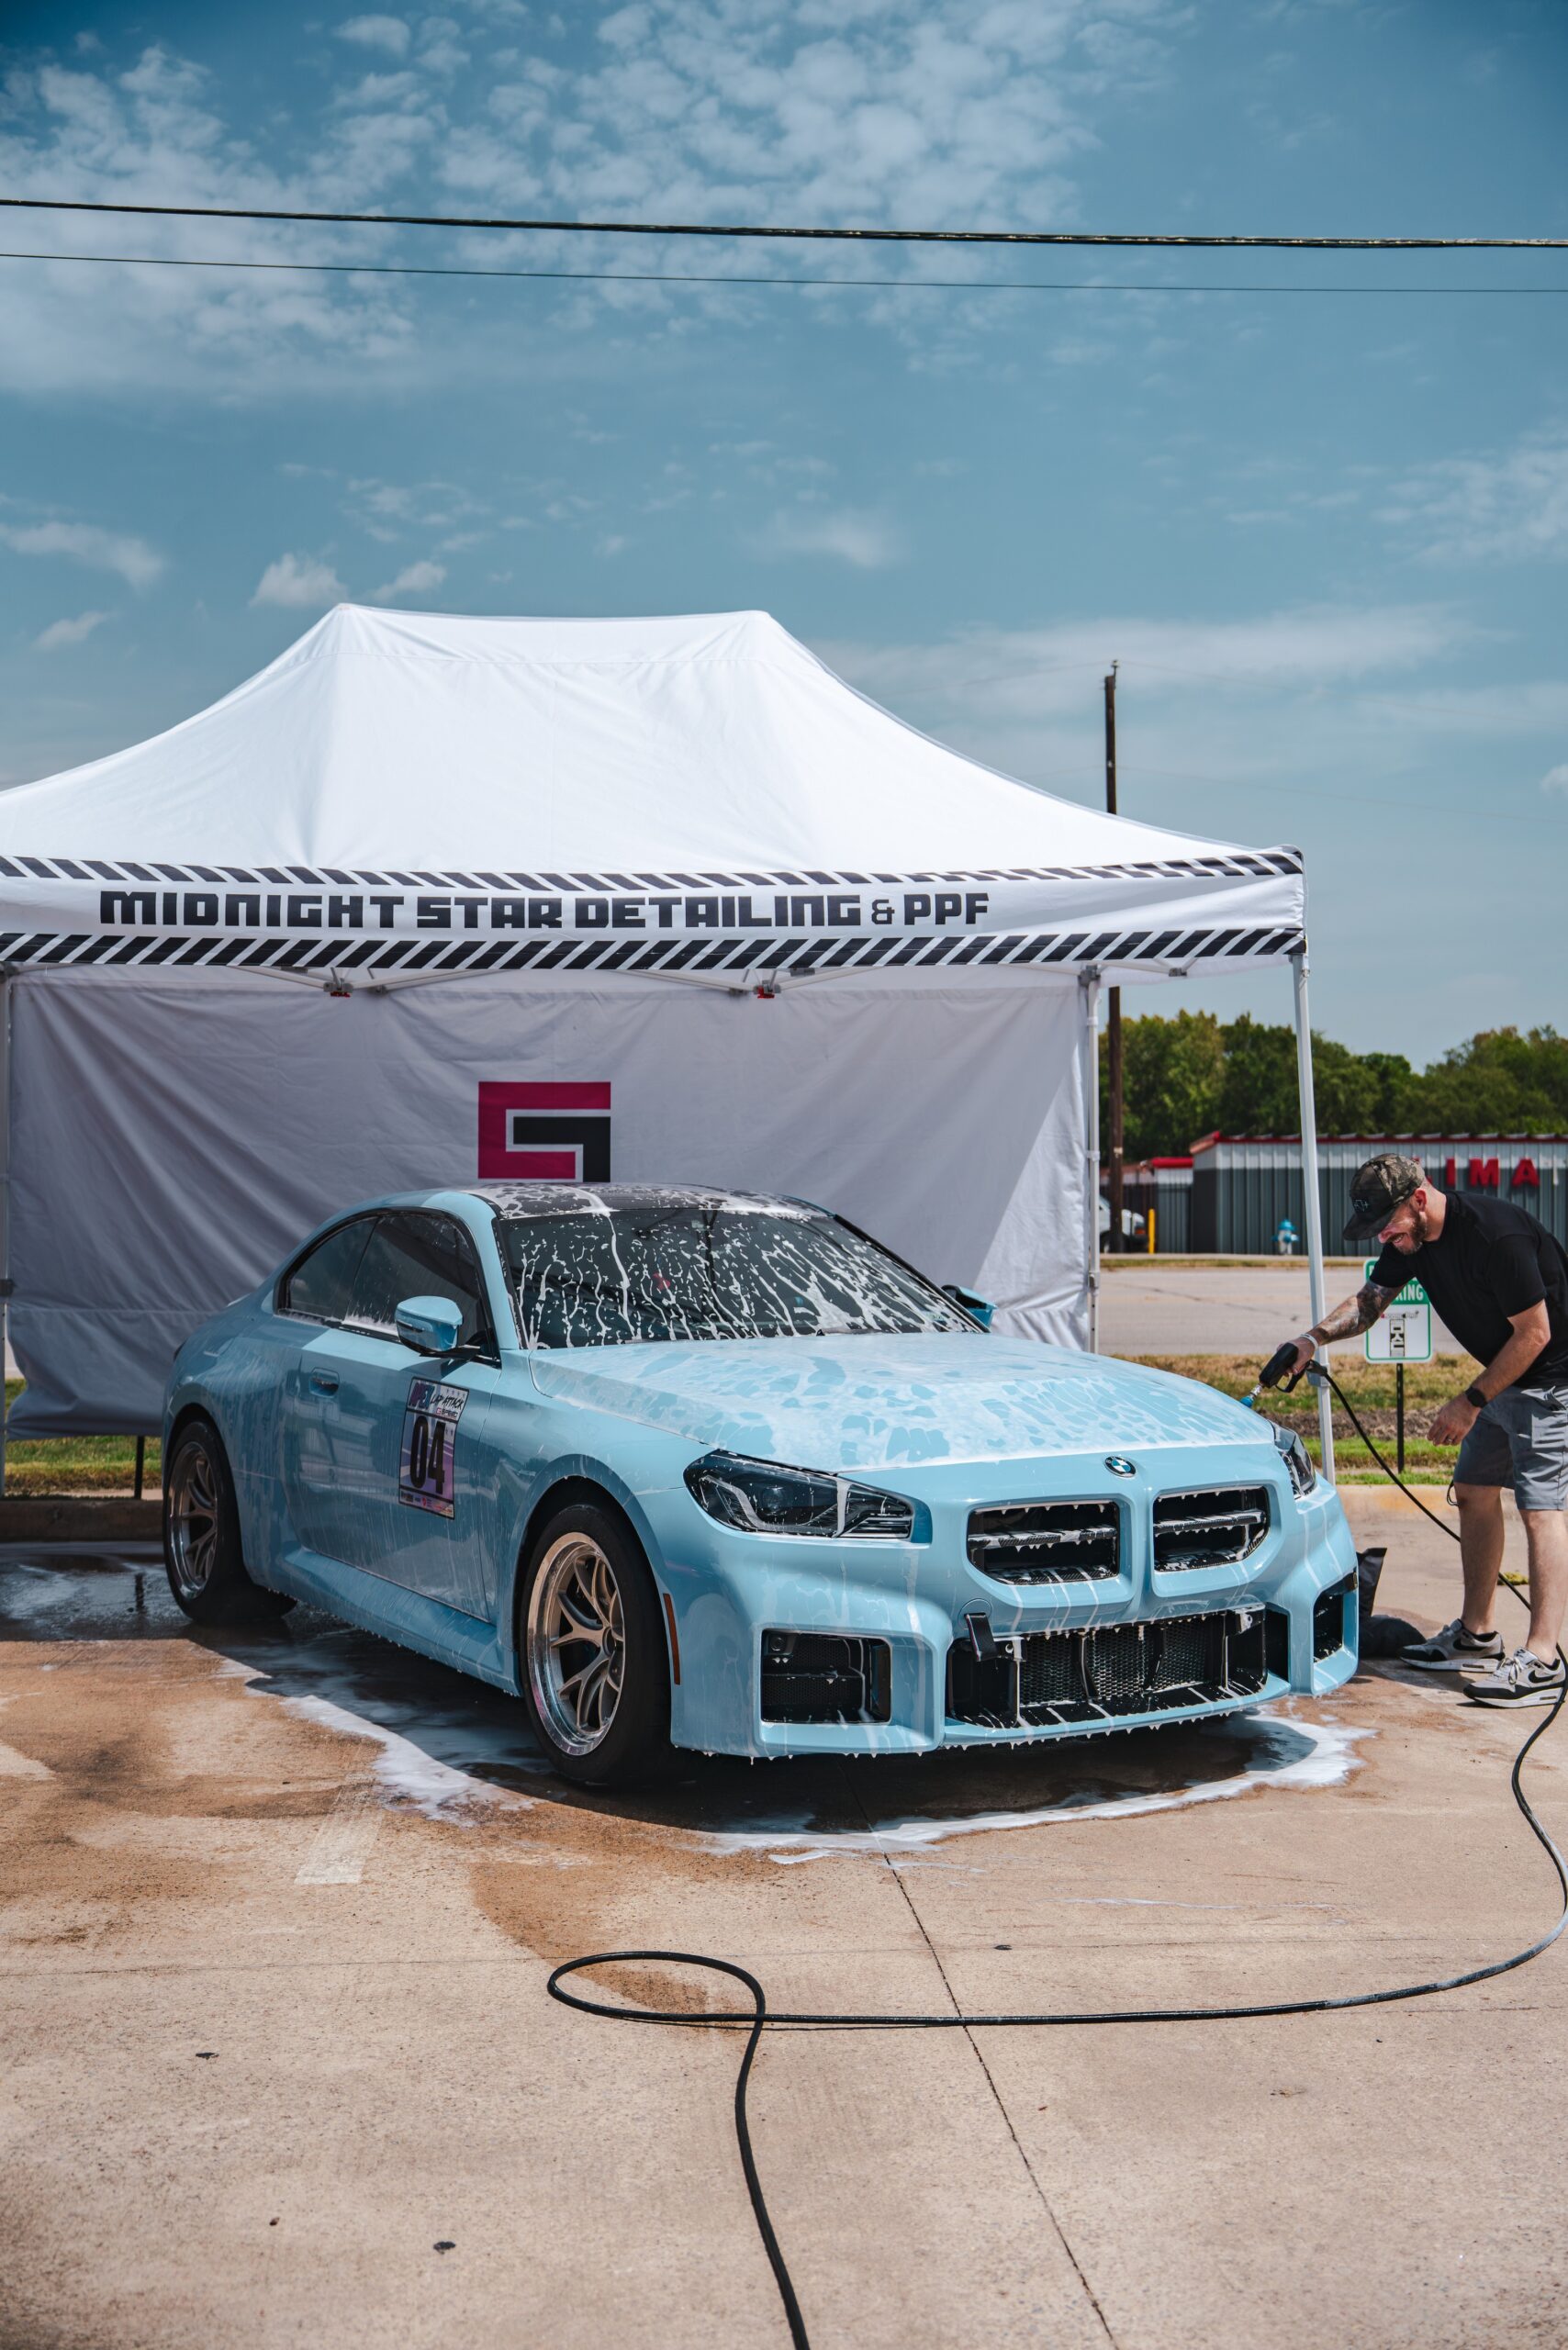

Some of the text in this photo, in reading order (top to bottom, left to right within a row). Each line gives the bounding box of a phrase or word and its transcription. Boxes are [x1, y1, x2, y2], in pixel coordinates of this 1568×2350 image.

[100, 891, 989, 928] MIDNIGHT STAR DETAILING & PPF
[442, 1395, 465, 1411] ATTACK
[409, 1415, 446, 1494] 04
